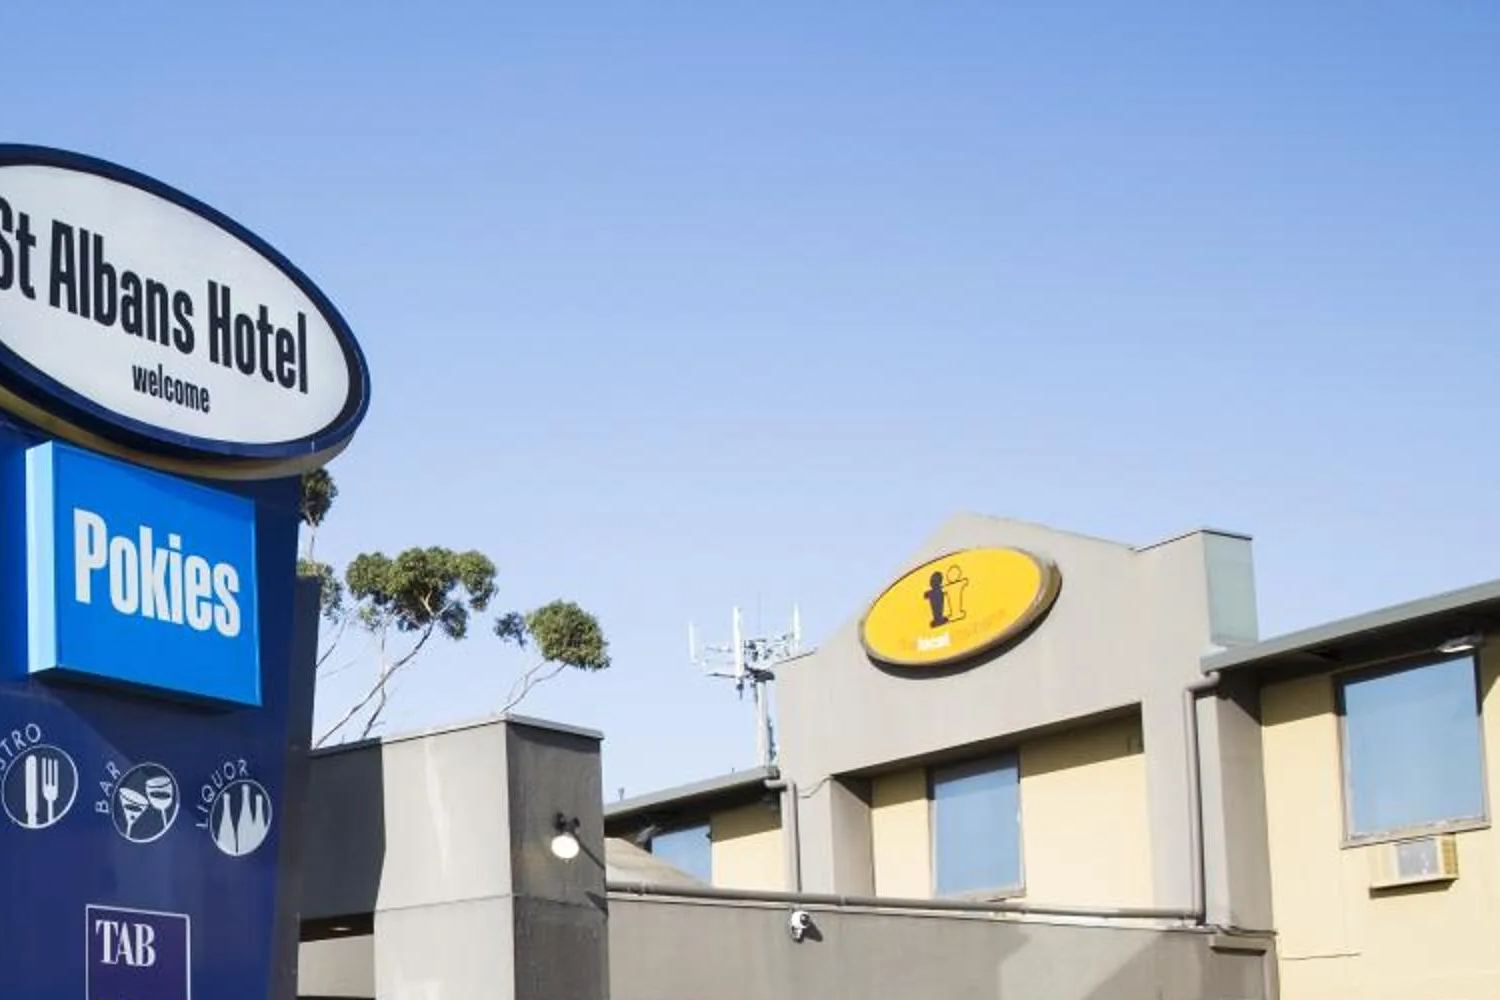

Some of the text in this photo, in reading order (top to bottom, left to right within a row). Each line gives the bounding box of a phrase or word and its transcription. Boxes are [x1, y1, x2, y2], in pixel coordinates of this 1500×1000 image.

[49, 219, 195, 355] Albans
[208, 280, 309, 394] Hotel
[132, 363, 211, 413] welcome
[73, 507, 240, 638] Pokies
[95, 760, 121, 814] BAR
[195, 759, 249, 829] LIQUOR
[95, 920, 156, 967] TAB
